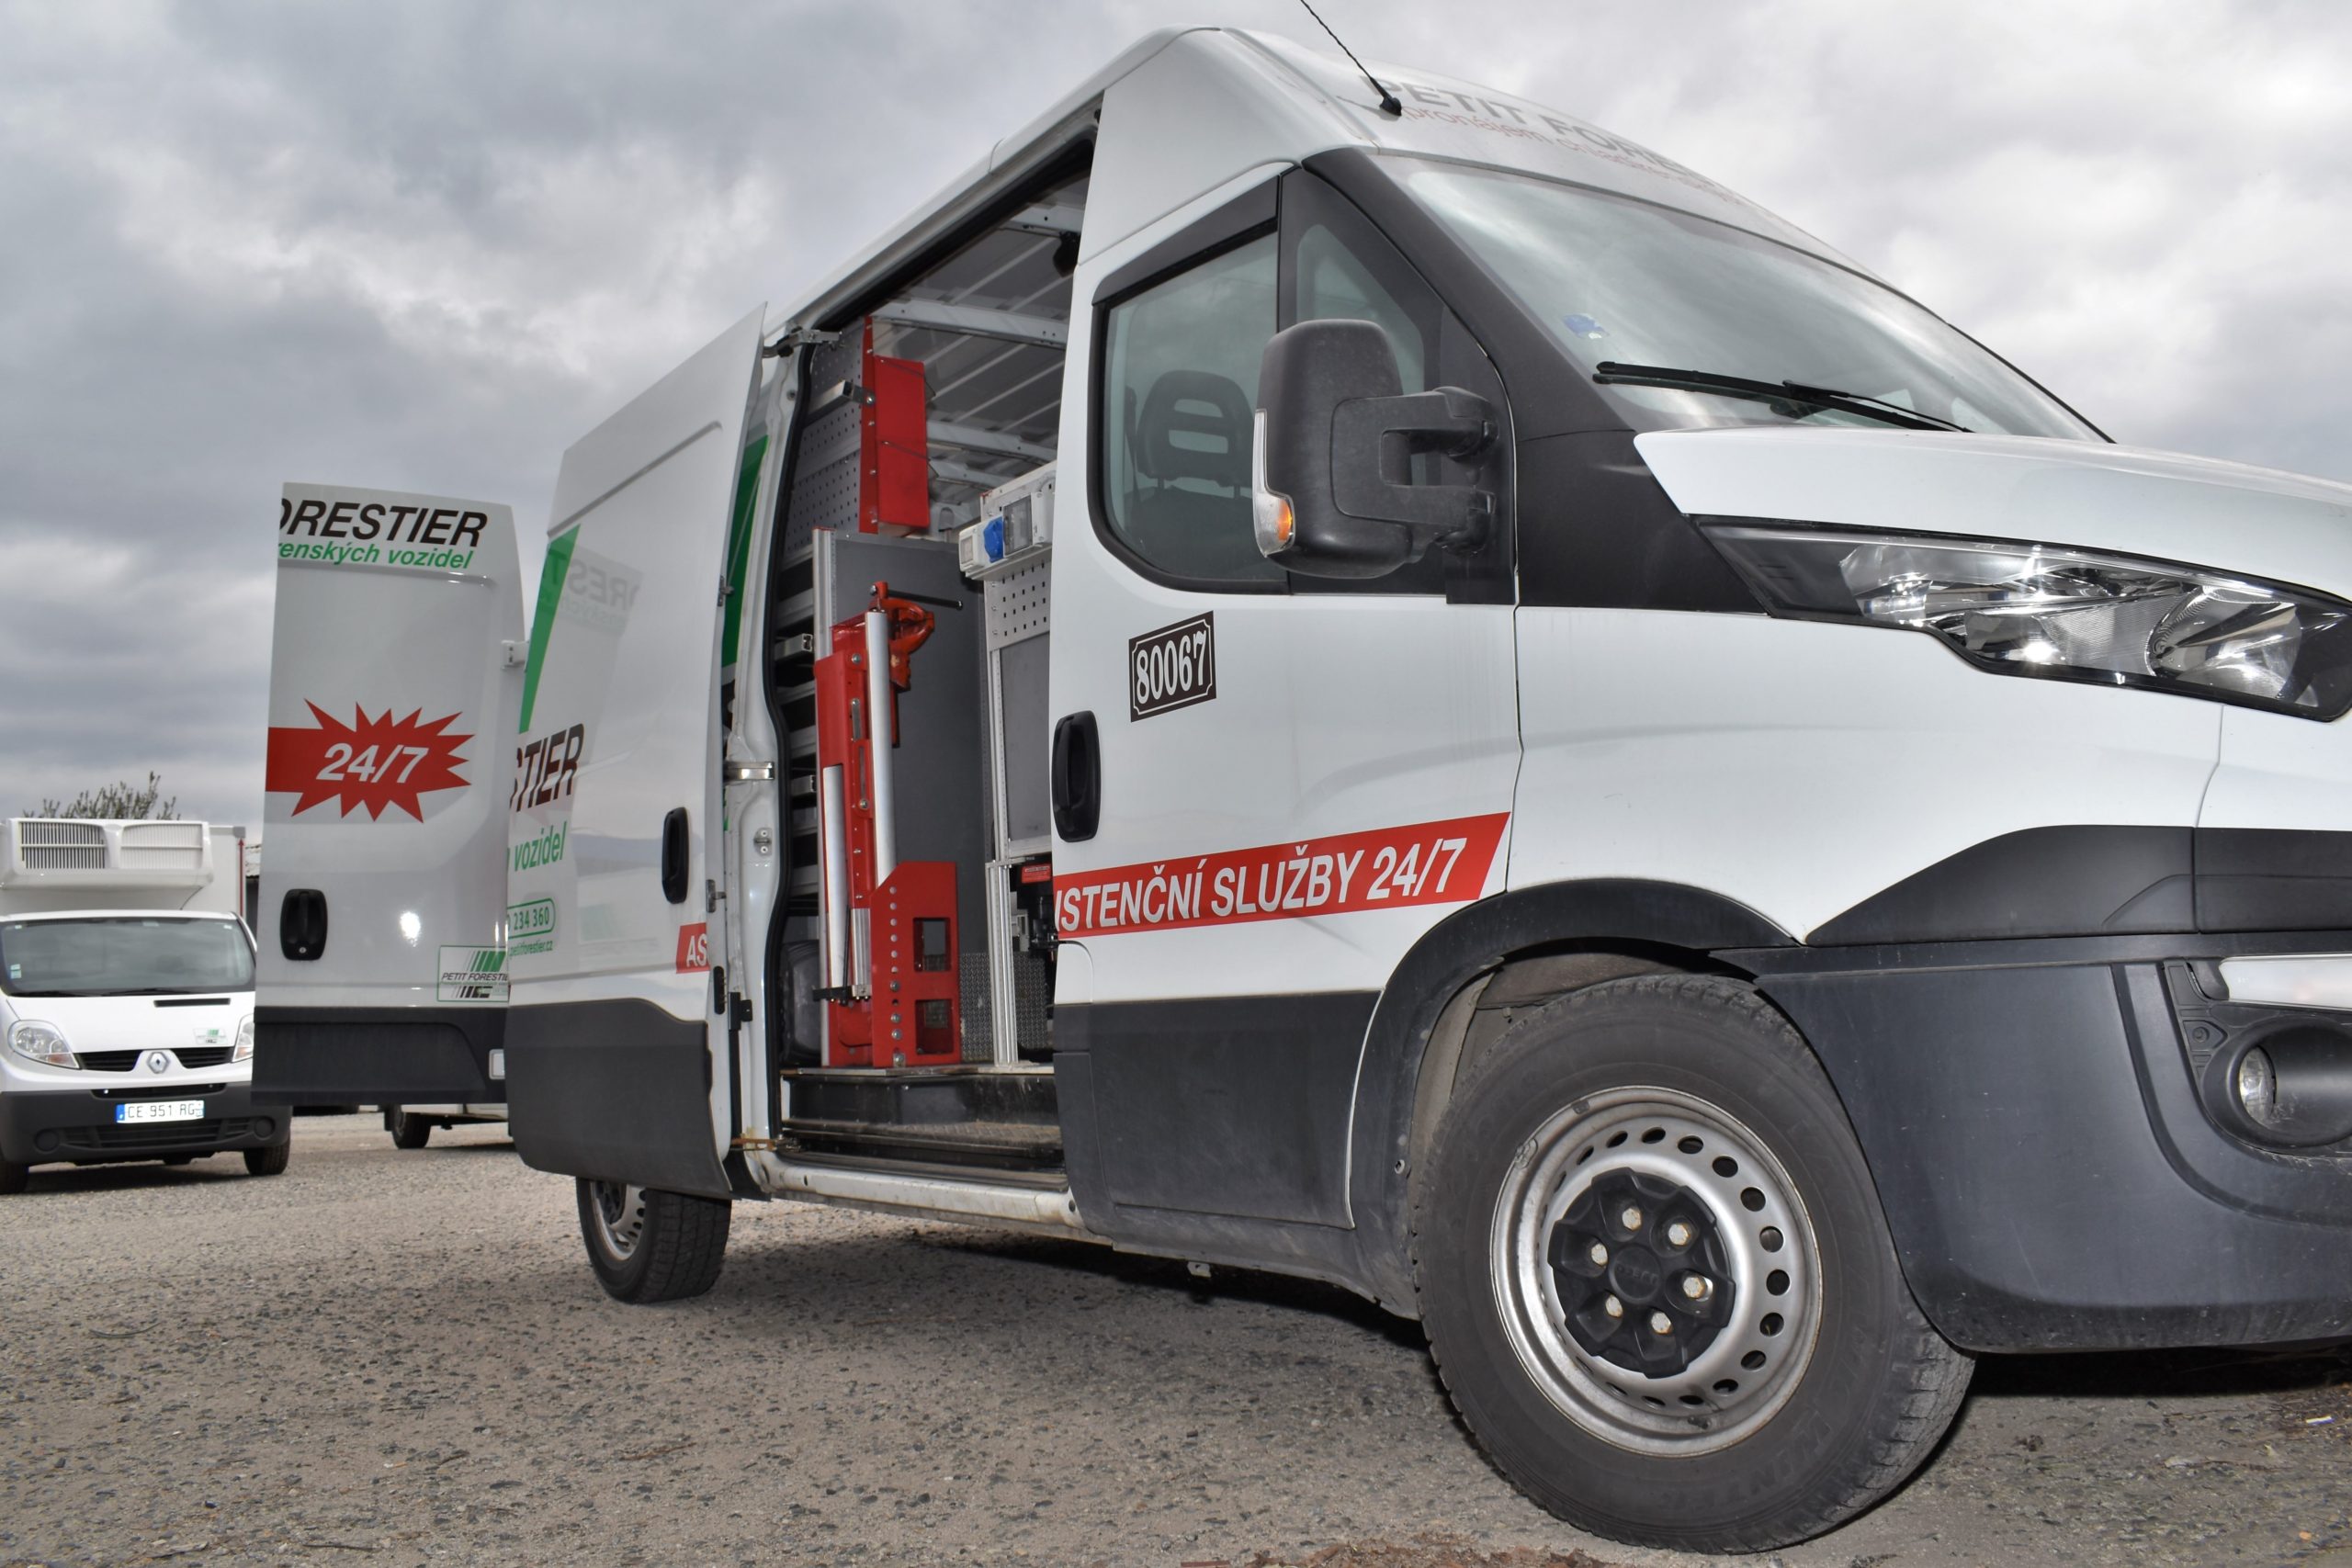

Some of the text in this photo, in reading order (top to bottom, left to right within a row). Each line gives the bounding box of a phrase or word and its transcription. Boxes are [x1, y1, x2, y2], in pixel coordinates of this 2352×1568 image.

[1360, 75, 1527, 125] PETIT
[278, 540, 474, 569] enských vozidel
[1136, 630, 1206, 705] 80067
[316, 742, 429, 784] 24/7
[514, 820, 567, 872] vozidel
[1055, 838, 1468, 932] ISTENČNÍ SLUŽBY 24/7
[514, 909, 530, 931] 234
[533, 906, 550, 927] 360
[442, 972, 467, 981] PETIT
[128, 1102, 195, 1119] CE 951 AG
